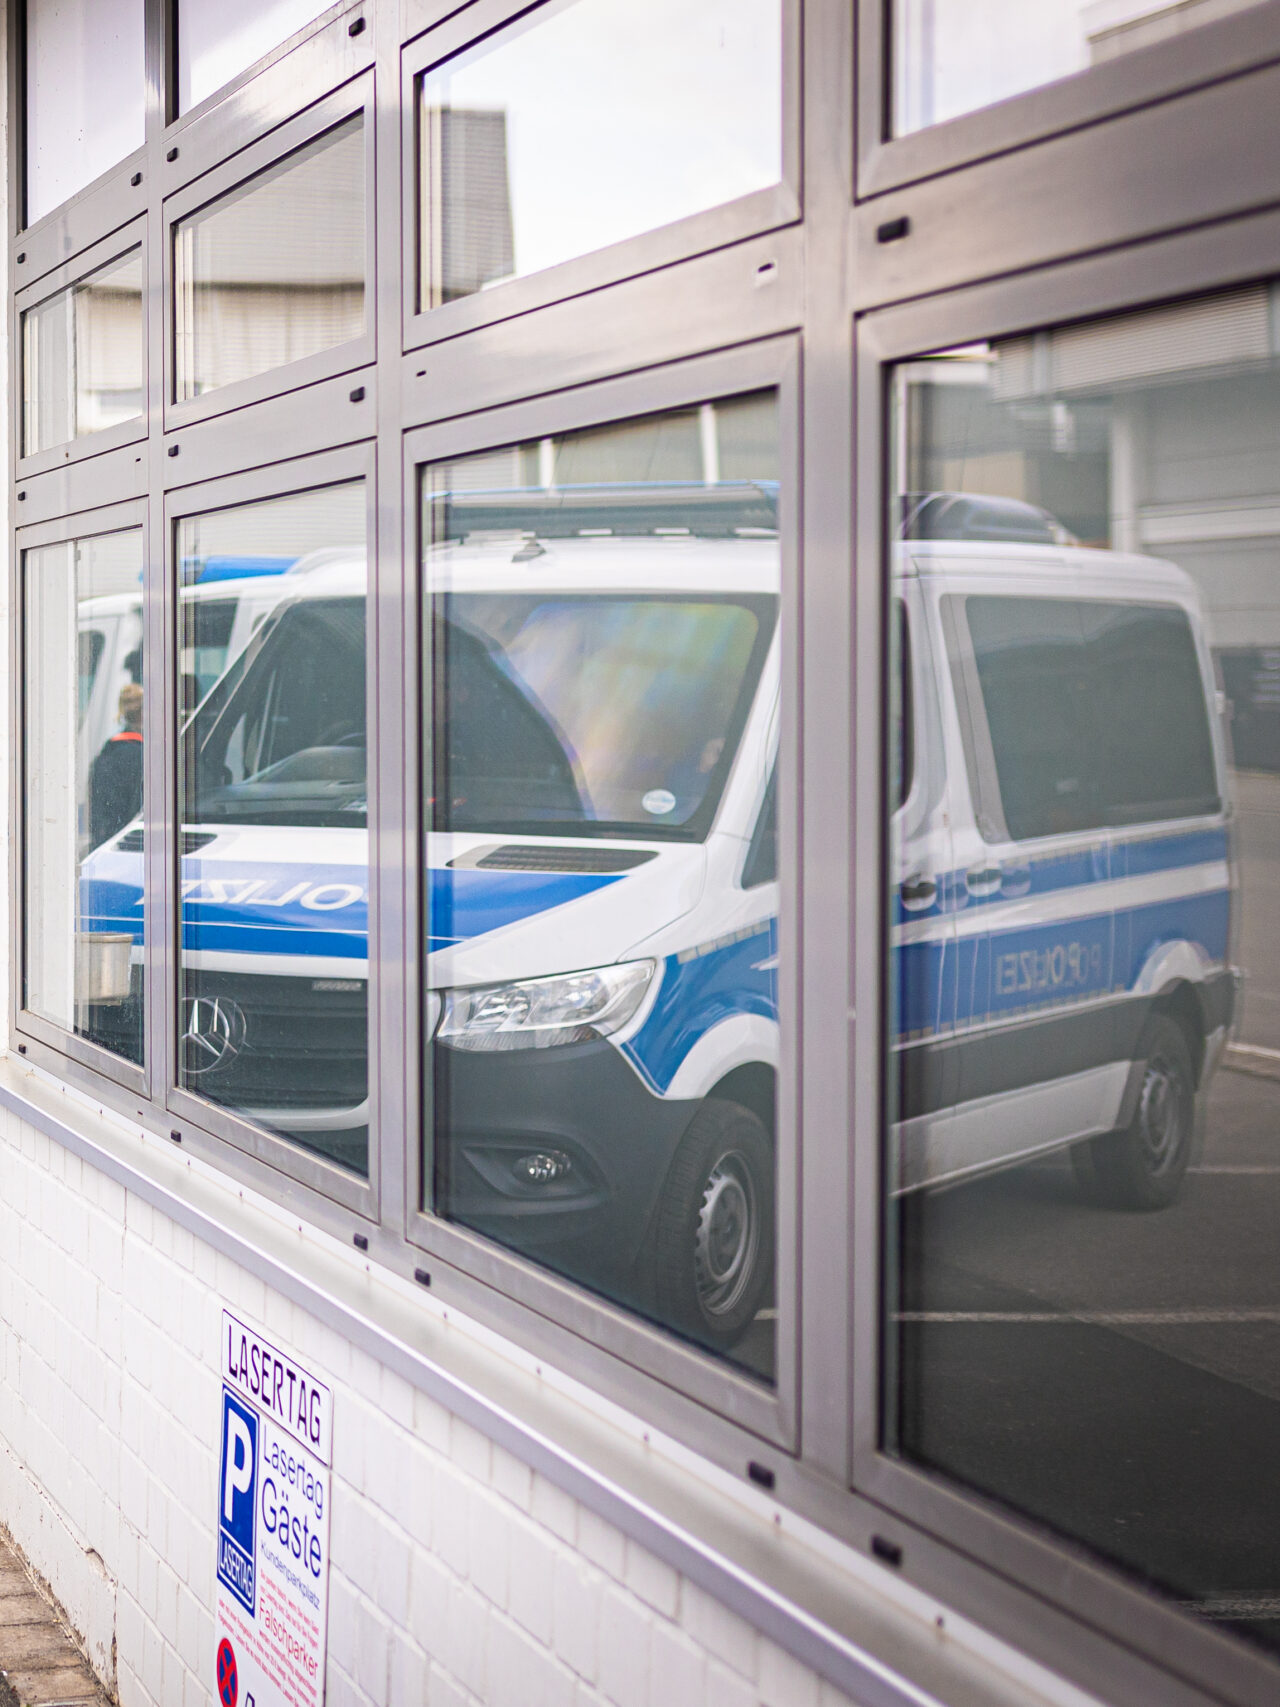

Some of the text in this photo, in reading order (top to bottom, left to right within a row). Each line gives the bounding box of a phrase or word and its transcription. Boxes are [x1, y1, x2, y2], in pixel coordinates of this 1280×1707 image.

[228, 1323, 321, 1448] LASERTAG
[224, 1407, 253, 1523] P
[263, 1423, 323, 1520] Lasertag
[219, 1539, 253, 1599] LASERTAG
[261, 1477, 322, 1578] Gäste
[259, 1596, 319, 1680] Falschparker
